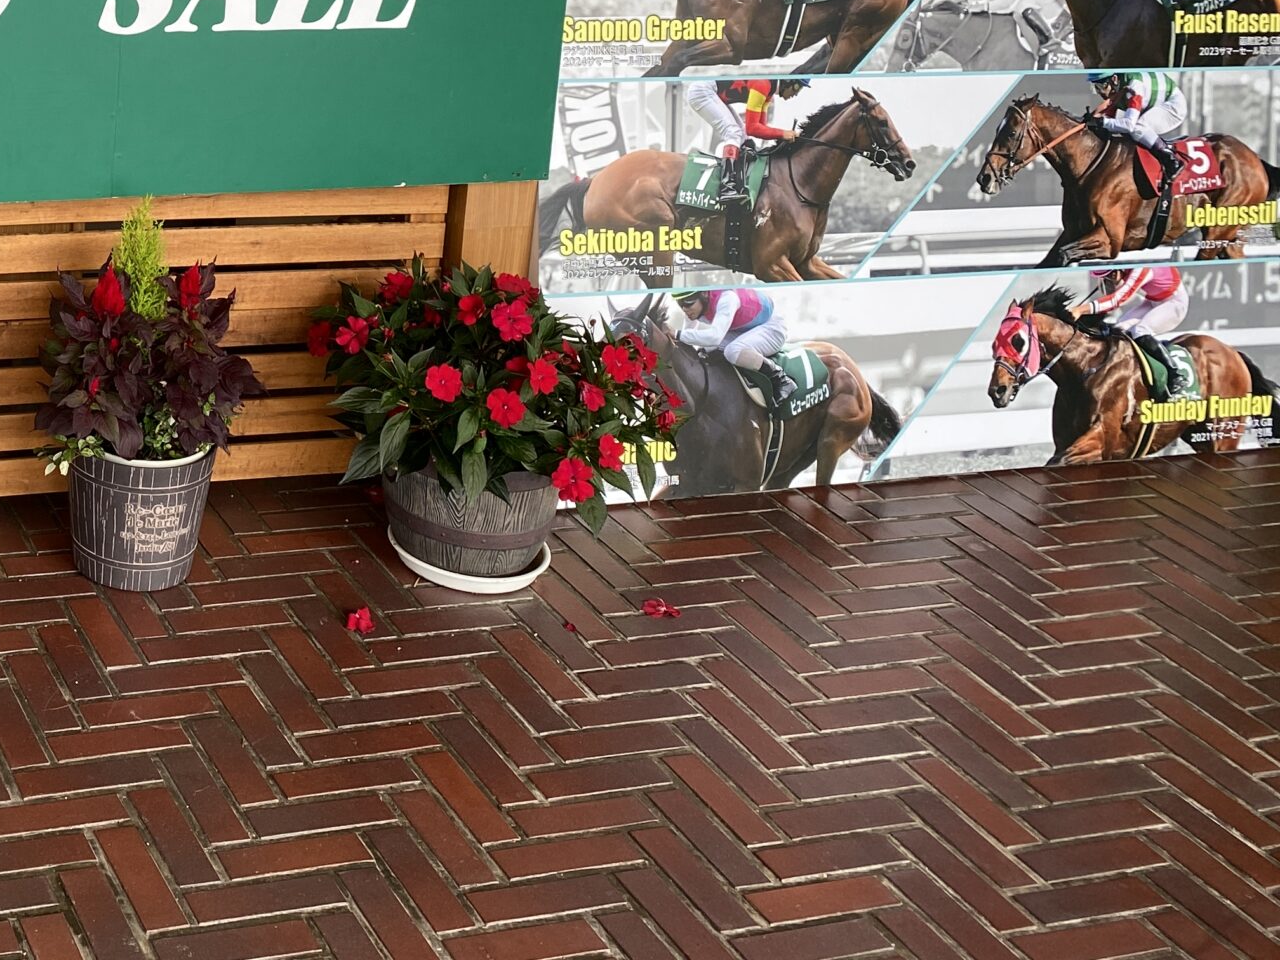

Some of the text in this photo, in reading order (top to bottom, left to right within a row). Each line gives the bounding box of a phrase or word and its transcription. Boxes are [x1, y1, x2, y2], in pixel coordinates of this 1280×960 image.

[561, 14, 726, 43] Sanono Greater
[1175, 9, 1280, 34] Faust Rasen
[1186, 140, 1211, 175] 5
[693, 157, 718, 190] 7
[1186, 200, 1277, 229] Lebensstil
[559, 225, 703, 257] Sekitoba East
[1140, 397, 1208, 424] Sunday
[1209, 394, 1273, 419] Funday
